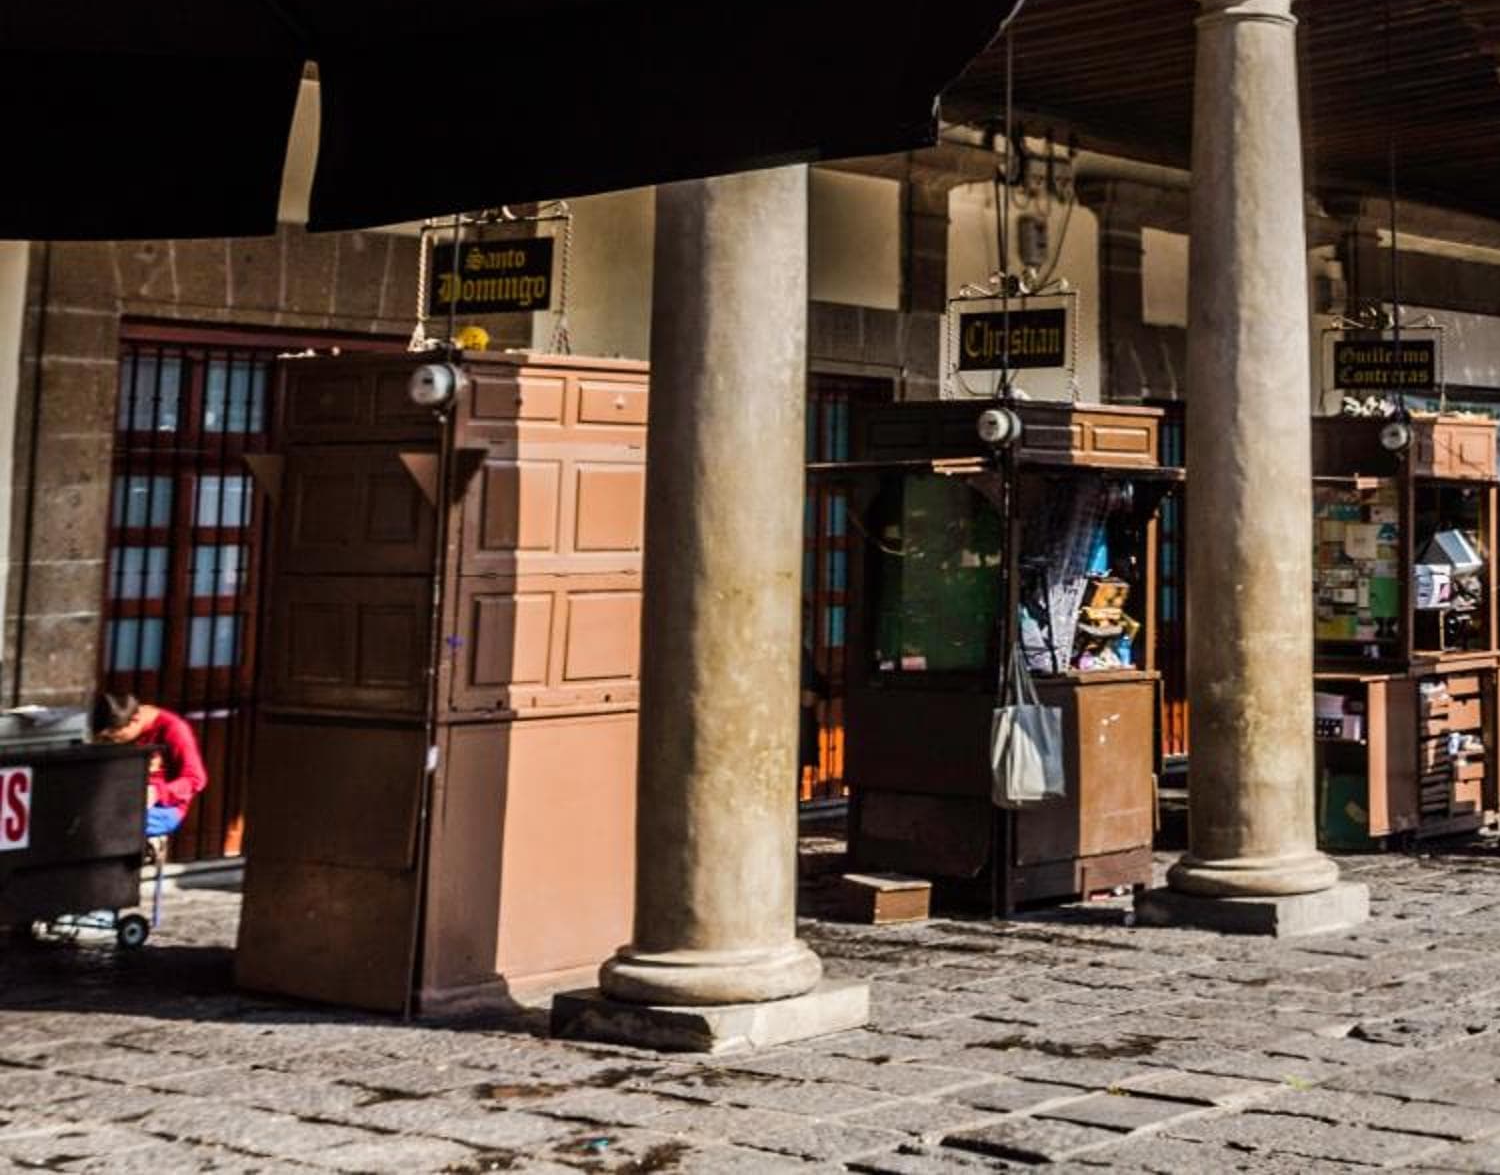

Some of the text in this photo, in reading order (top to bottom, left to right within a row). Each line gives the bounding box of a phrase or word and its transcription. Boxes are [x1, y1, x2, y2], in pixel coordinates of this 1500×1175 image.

[465, 247, 525, 271] Santo
[438, 272, 546, 306] Domingo
[964, 320, 1060, 358] Chrstian
[1339, 346, 1429, 363] Guillemo
